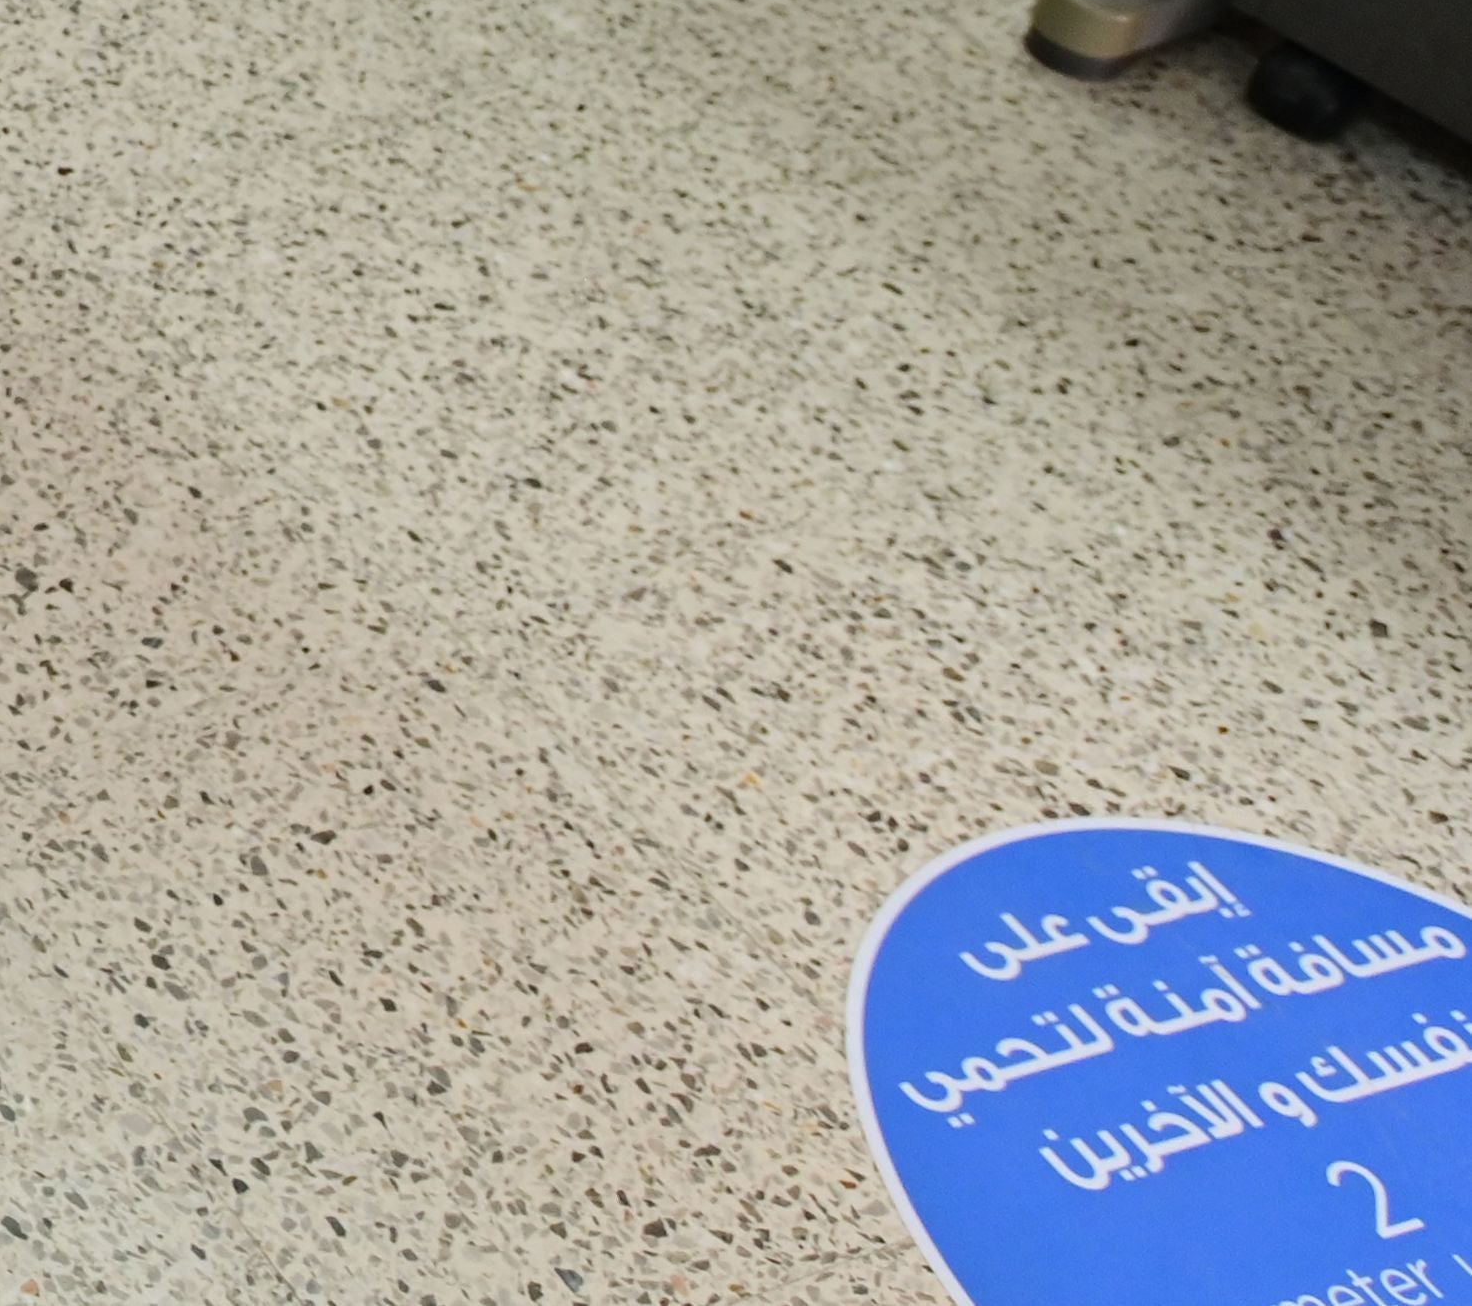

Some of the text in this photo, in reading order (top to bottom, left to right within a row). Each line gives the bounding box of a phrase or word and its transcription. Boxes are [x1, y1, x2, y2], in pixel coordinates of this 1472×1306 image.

[959, 912, 1090, 980] على
[898, 926, 1466, 1128] مسافة آمنة لتحمي
[1039, 1079, 1265, 1190] الآخرين
[1258, 1082, 1318, 1128] و
[1326, 1161, 1425, 1239] 2
